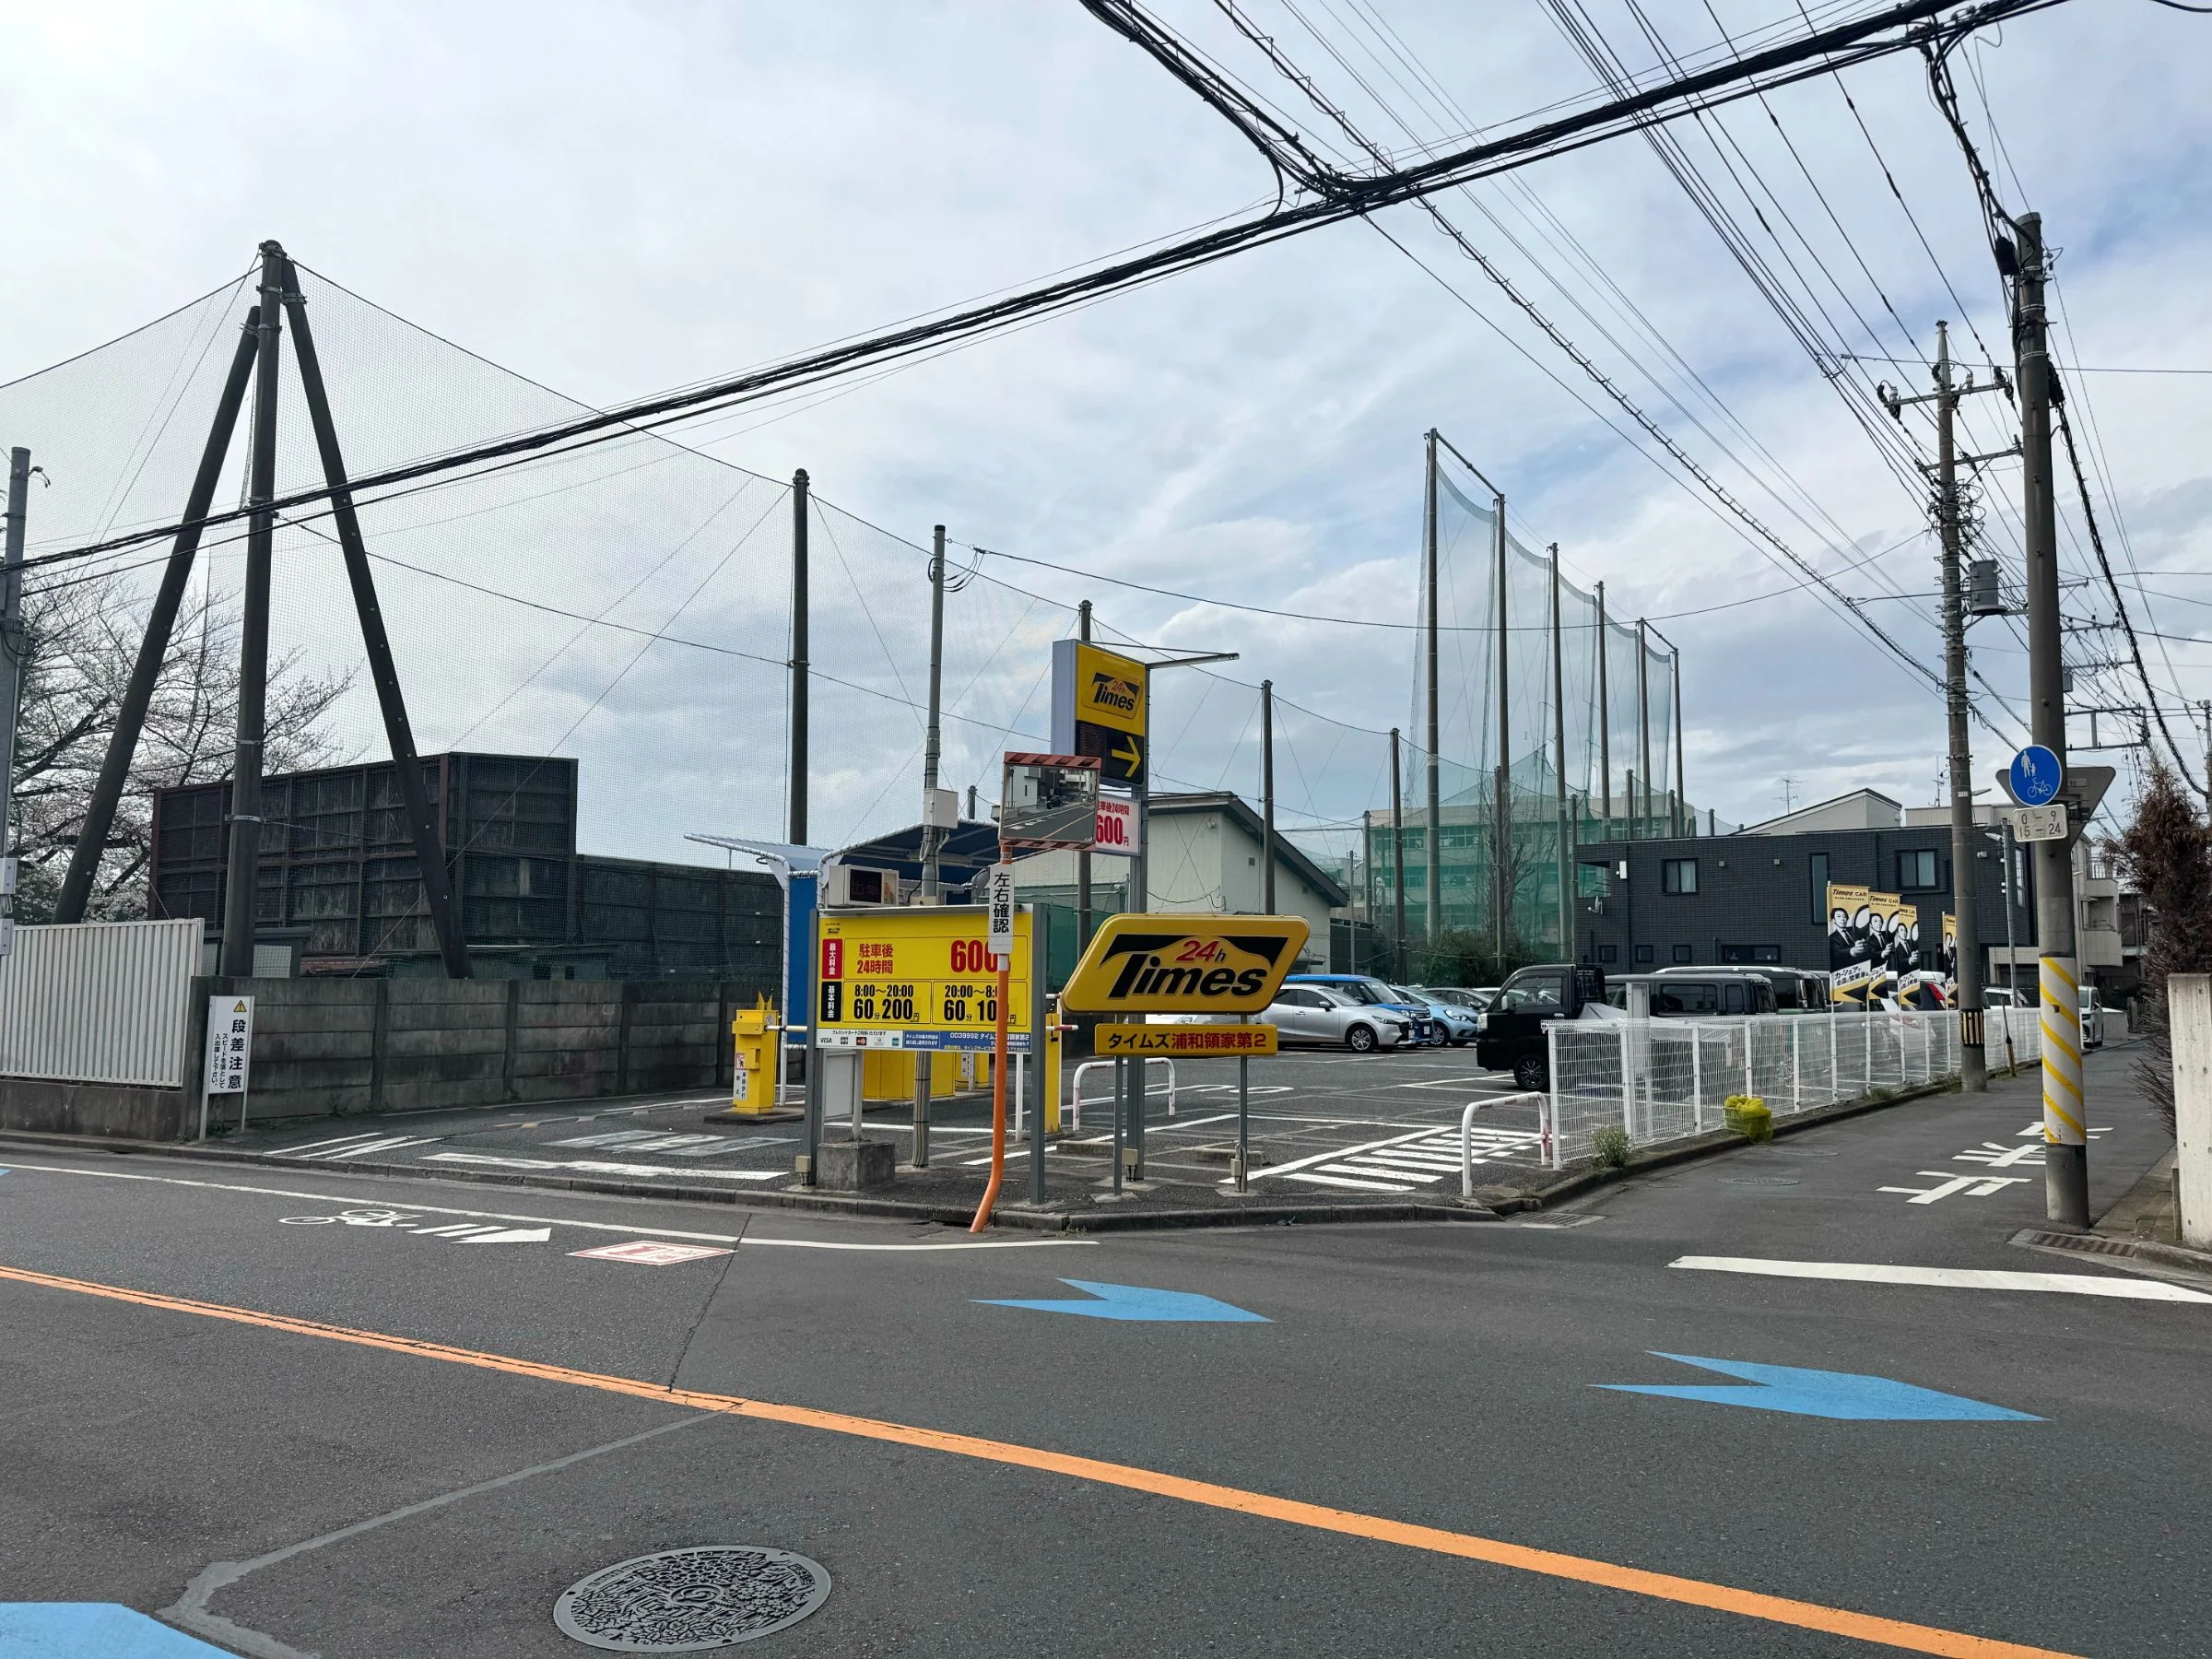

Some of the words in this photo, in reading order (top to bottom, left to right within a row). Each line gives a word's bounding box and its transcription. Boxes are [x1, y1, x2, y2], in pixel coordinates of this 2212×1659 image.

[1093, 681, 1135, 711] Times
[994, 872, 1010, 933] 左右確認
[1833, 888, 1853, 897] Times
[859, 944, 893, 958] 駐車後
[1176, 940, 1226, 963] 24h
[857, 960, 893, 973] 24時間
[1107, 954, 1267, 998] Times
[1109, 1033, 1266, 1050] タイムズ浦和領家第2
[228, 1019, 246, 1089] 段差注意
